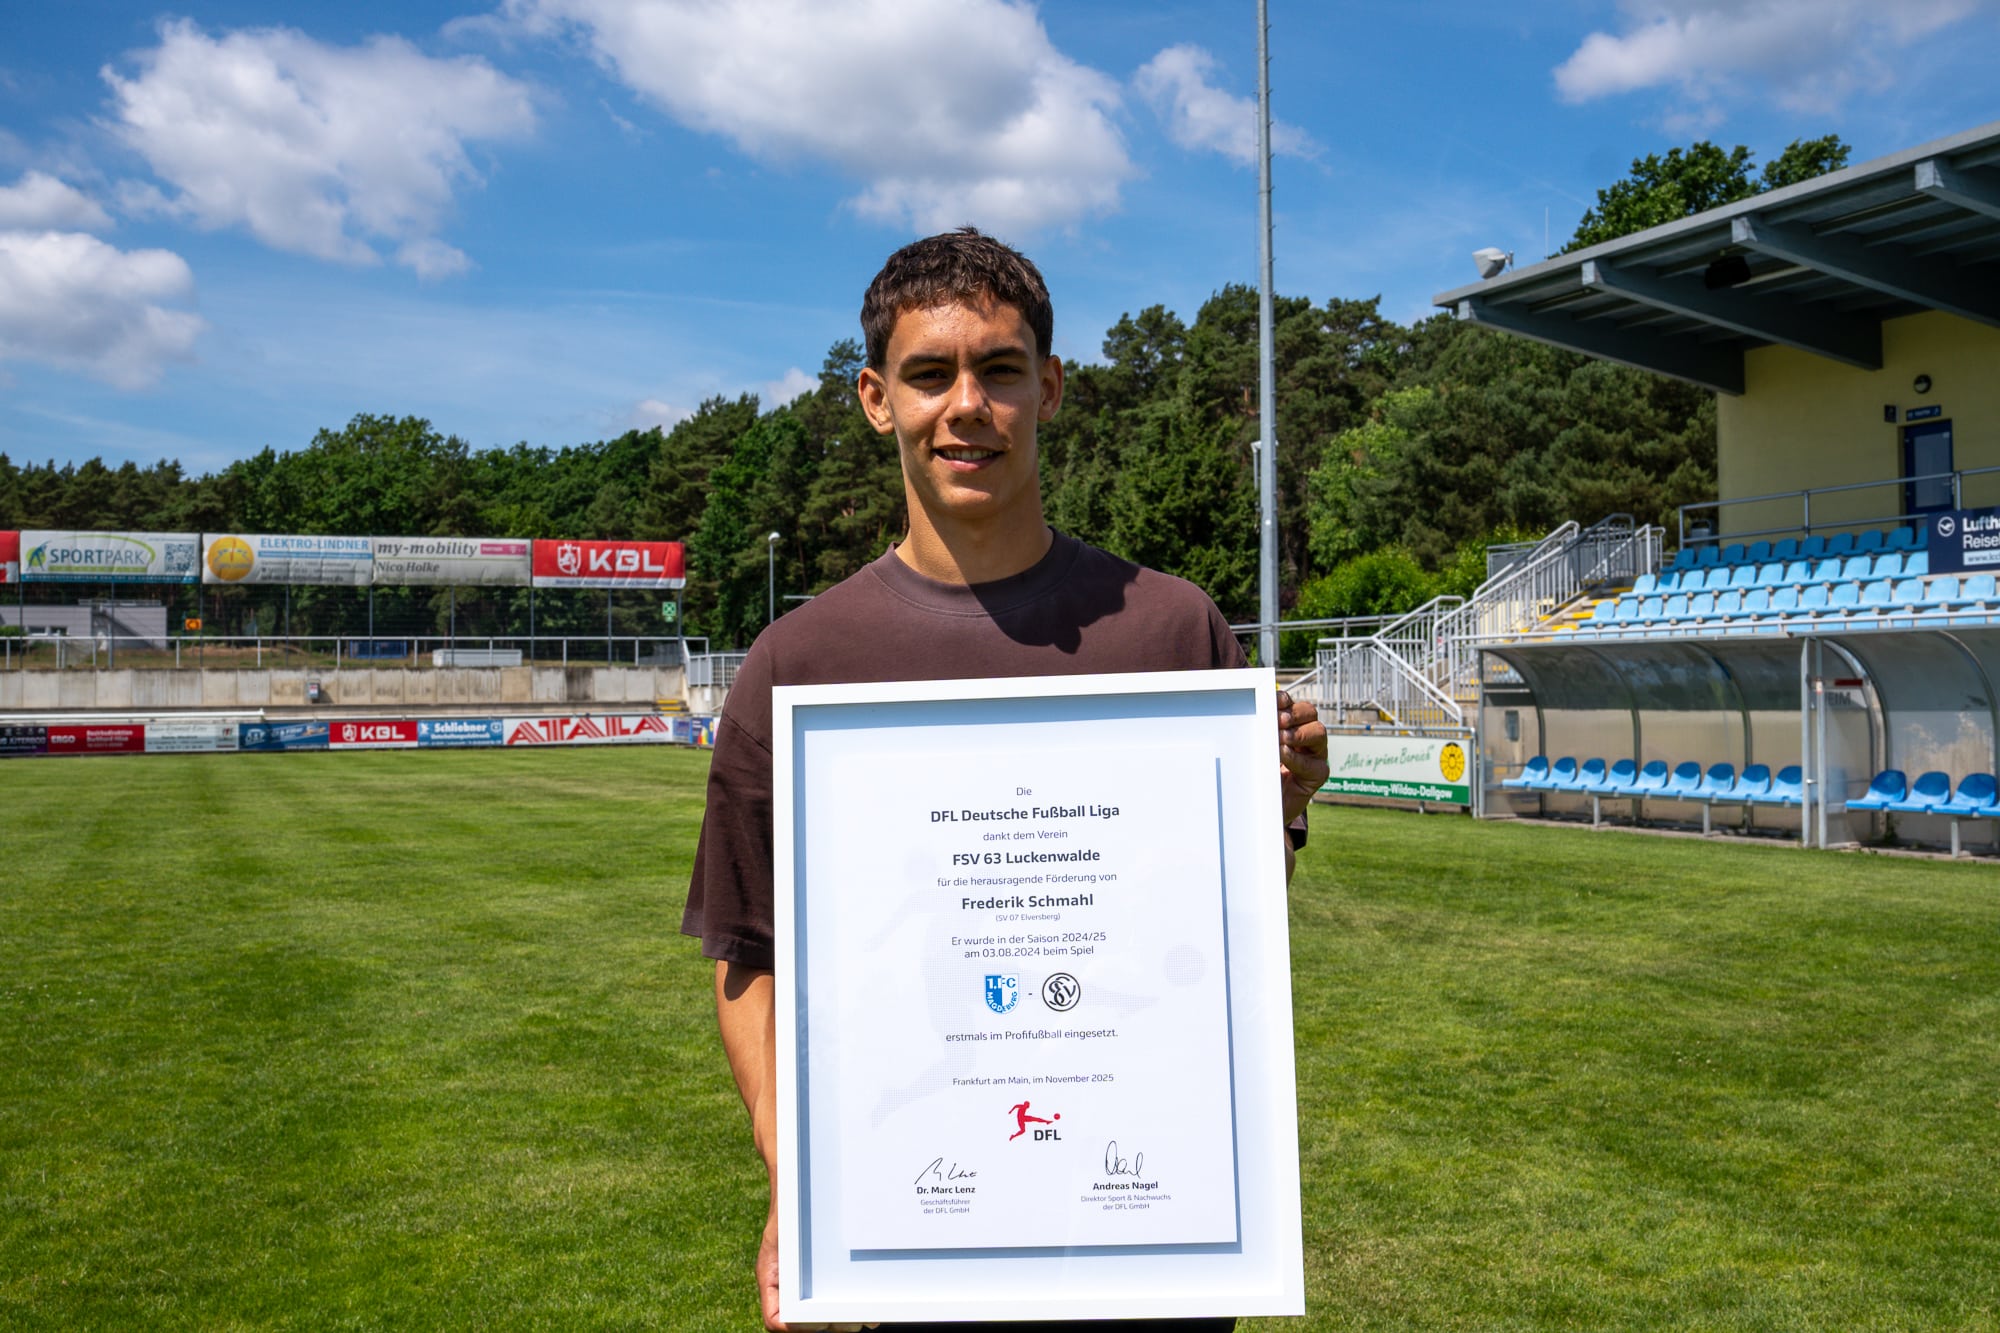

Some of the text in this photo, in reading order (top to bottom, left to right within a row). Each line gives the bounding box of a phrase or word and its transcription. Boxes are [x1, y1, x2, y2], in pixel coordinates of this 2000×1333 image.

[260, 538, 369, 550] ELEKTRO-LINDNER
[1963, 532, 2000, 549] Reise
[378, 541, 479, 557] my-mobility
[50, 548, 145, 564] SPORTPARK
[589, 549, 665, 572] KBL
[377, 562, 404, 573] Nico
[406, 562, 440, 573] Holke
[361, 726, 405, 740] KBL
[434, 722, 487, 733] Schliebner
[507, 716, 669, 745] ATALA
[51, 735, 76, 744] ERGO
[1017, 786, 1032, 796] Die
[931, 805, 1119, 822] DFL Deutsche Fußball Liga
[983, 829, 1067, 841] dankt dem Verein
[953, 849, 1100, 865] FSV 63 Luckenwalde
[938, 873, 1117, 887] für die herausragende Förderung von
[962, 894, 1093, 909] Frederik Schmahl
[996, 912, 1060, 922] (SV 07 Elversberg)
[952, 931, 1106, 946] Er wurde in der Saison 2024/25
[965, 945, 1093, 959] am 03.08.2024 beim Spiel
[986, 977, 1017, 990] 1.FC
[985, 991, 1018, 1013] MAGDEBURG
[946, 1029, 1118, 1042] erstmals im Profifußball eingesetzt.
[953, 1077, 990, 1086] Frankfurt
[1008, 1076, 1030, 1085] Main,
[1046, 1074, 1089, 1084] November
[1092, 1073, 1113, 1083] 2025
[1034, 1129, 1061, 1141] DFL
[917, 1185, 975, 1195] Dr. Marc Lenz
[1093, 1180, 1158, 1192] Andreas Nagel
[921, 1198, 969, 1206] Geschäftsführer
[1108, 1194, 1125, 1204] Sport
[1134, 1193, 1171, 1201] Nachwuchs
[924, 1207, 933, 1215] der
[1103, 1202, 1149, 1211] der DFL GmbH
